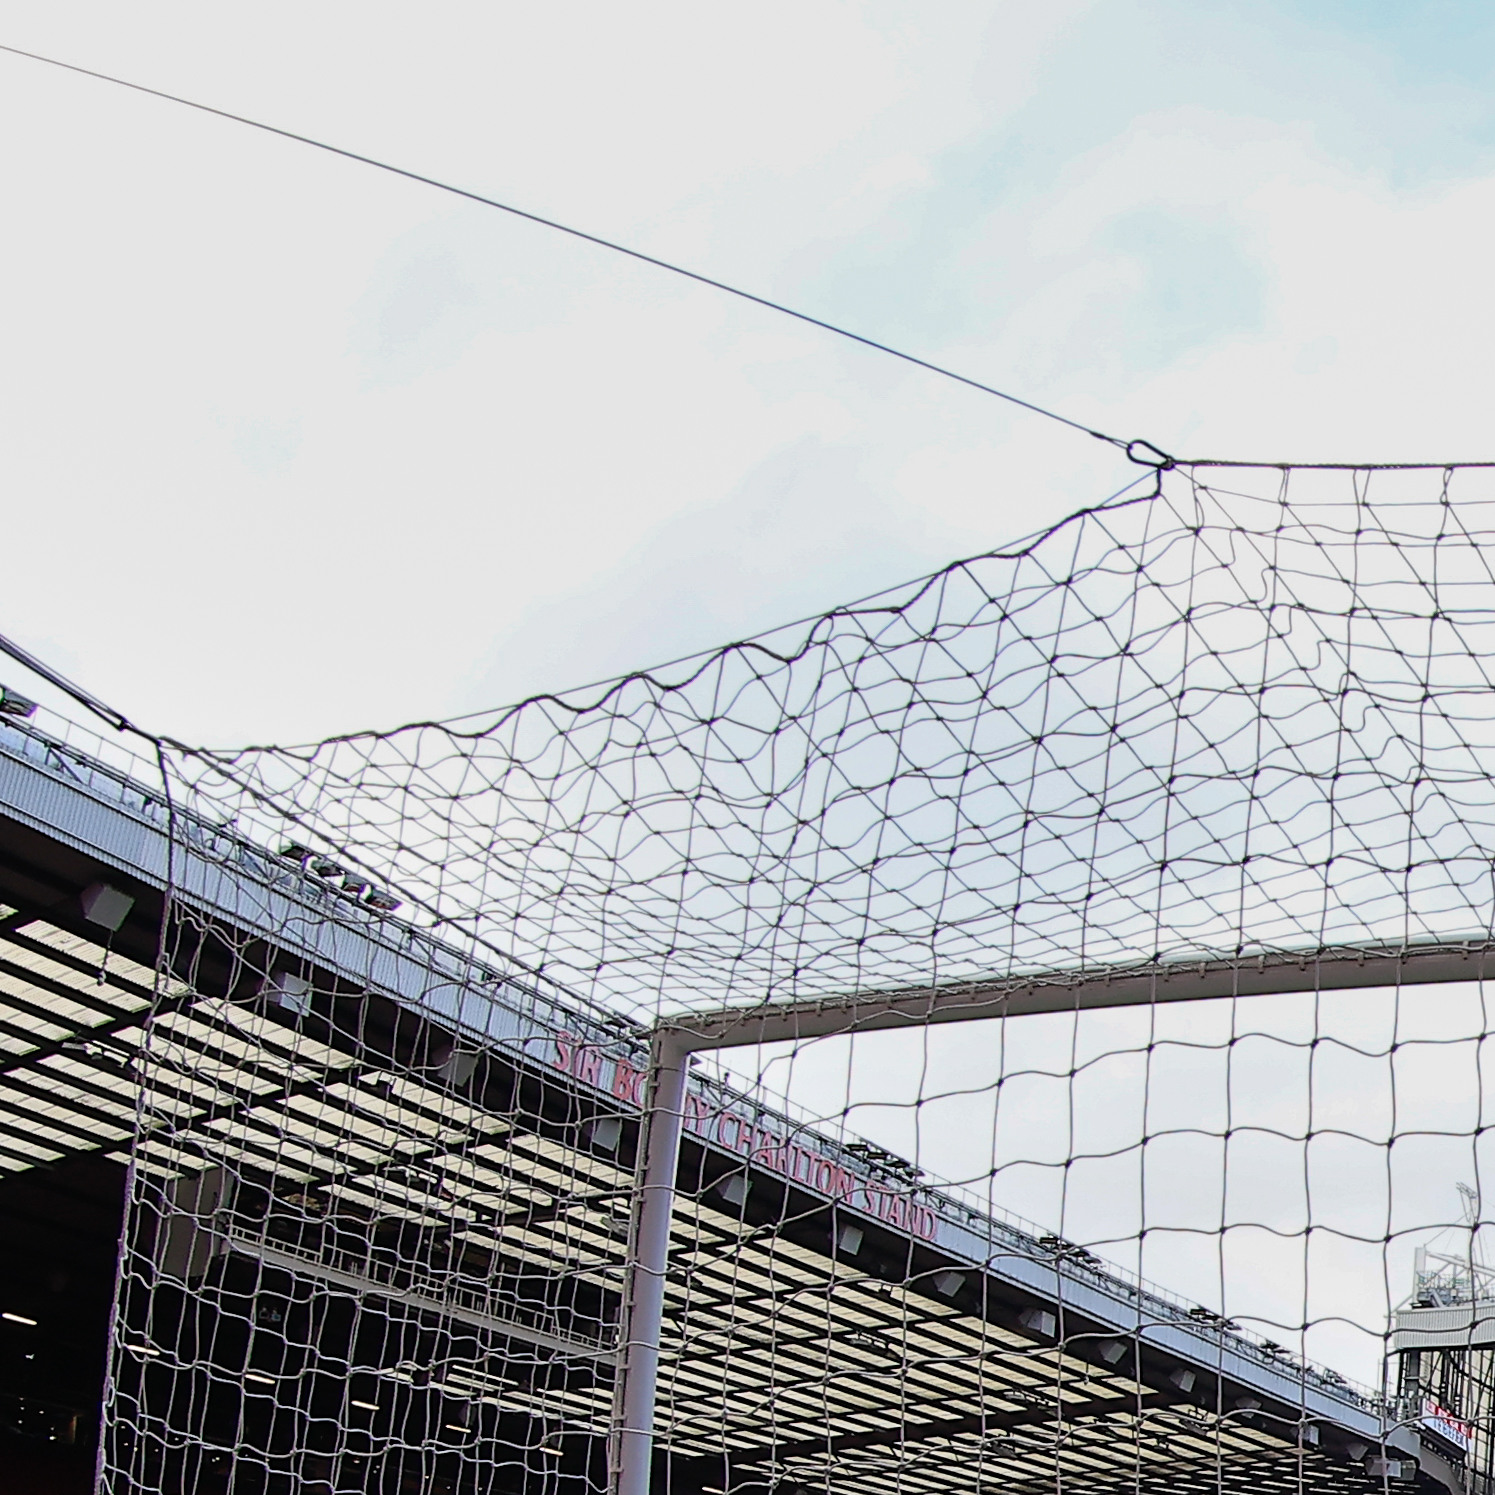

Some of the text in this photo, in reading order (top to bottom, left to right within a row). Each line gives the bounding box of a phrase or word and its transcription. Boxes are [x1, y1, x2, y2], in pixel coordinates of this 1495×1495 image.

[553, 1031, 603, 1086] SIR
[718, 1111, 856, 1204] CHARLTON
[864, 1181, 937, 1241] STAND
